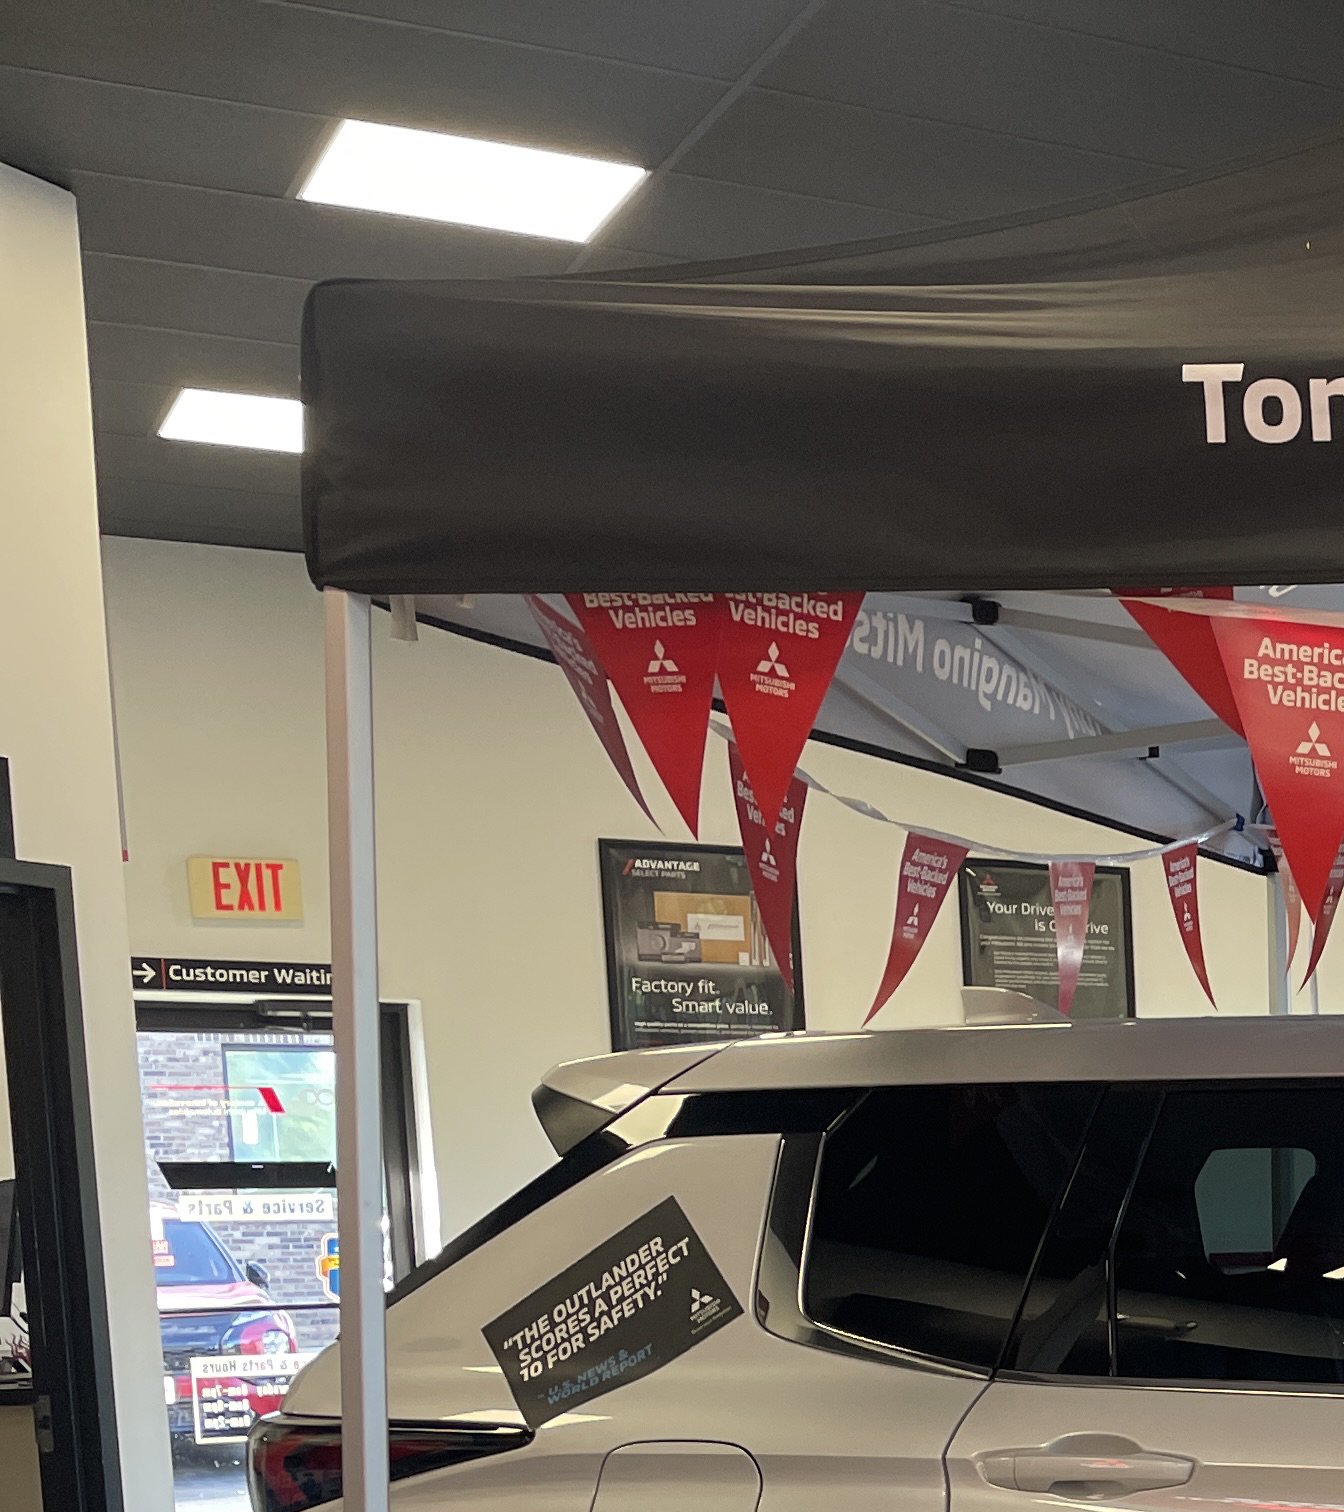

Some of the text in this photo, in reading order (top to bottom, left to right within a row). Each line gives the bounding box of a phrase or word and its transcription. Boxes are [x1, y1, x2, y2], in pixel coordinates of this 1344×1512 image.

[608, 605, 697, 630] Vehicles
[725, 592, 843, 621] st-Backed
[729, 600, 820, 639] Vehicles
[1288, 755, 1338, 769] MITSUBISHI
[1295, 765, 1331, 778] MOTORS
[634, 858, 700, 871] ADVANTAGE
[211, 861, 283, 912] EXIT
[986, 901, 1054, 916] Your Drive
[168, 964, 269, 984] Customer
[631, 977, 720, 997] Factory fit.
[672, 998, 773, 1016] Smart value.
[552, 1236, 666, 1319] OUTLANDER
[518, 1237, 690, 1368] SCORES A PERFECT
[519, 1361, 543, 1382] 10
[546, 1333, 586, 1369] FOR
[577, 1355, 616, 1382] NEWS
[547, 1343, 652, 1405] WORLD REPORT
